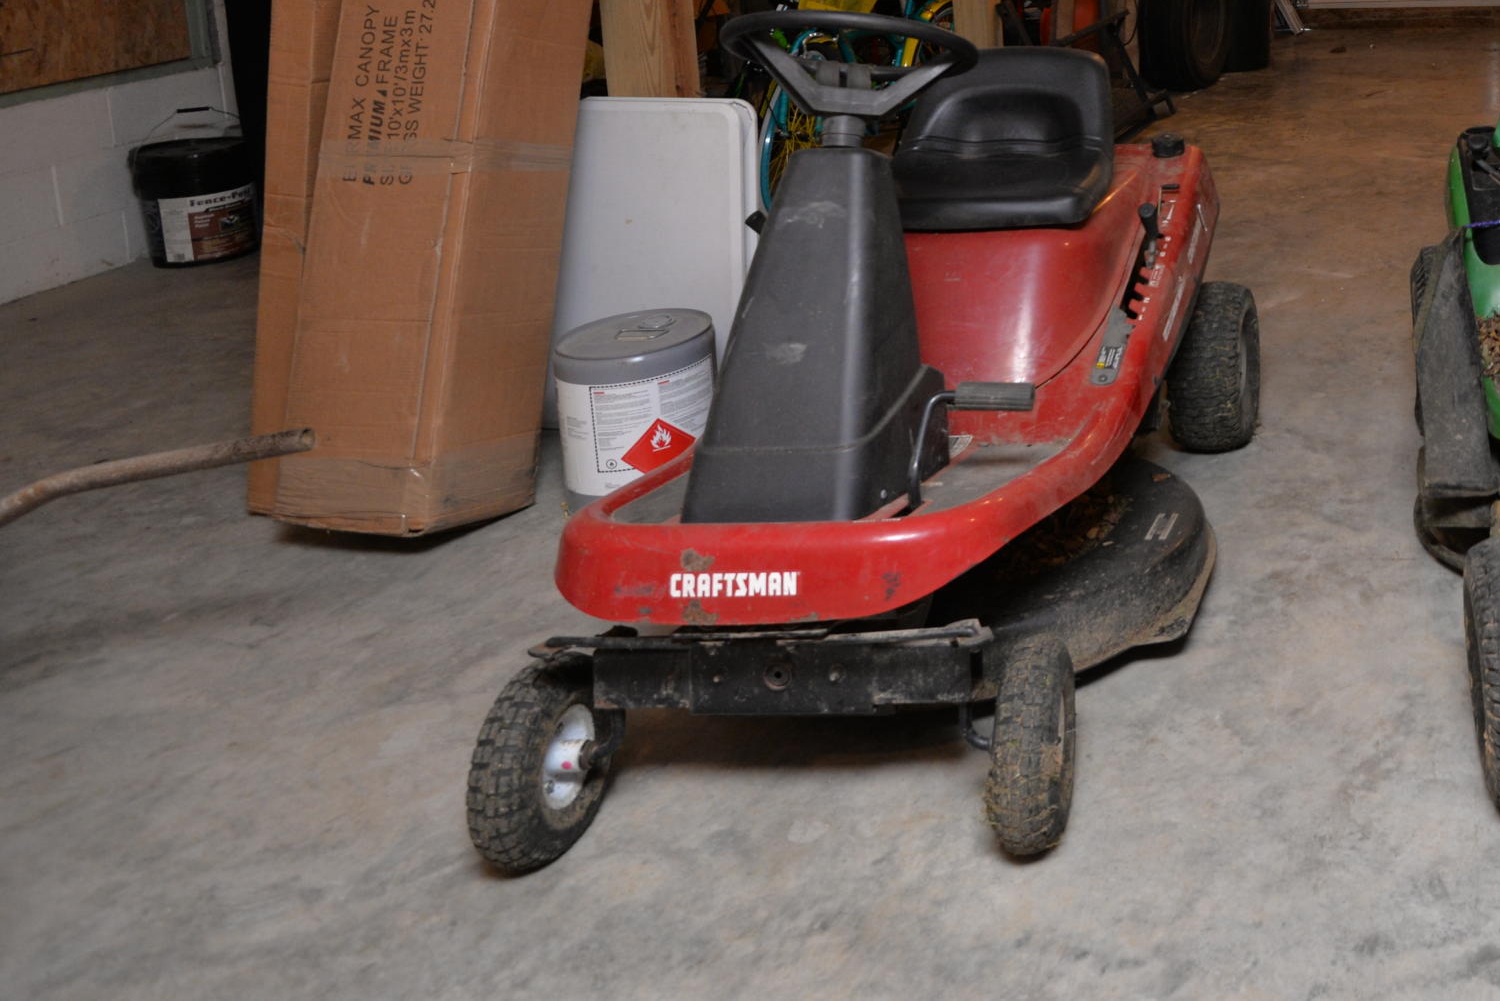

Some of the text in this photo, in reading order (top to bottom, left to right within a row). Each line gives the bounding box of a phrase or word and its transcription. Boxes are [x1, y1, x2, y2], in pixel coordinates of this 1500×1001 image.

[355, 5, 380, 87] CANOPY
[362, 15, 398, 186] PRMIUM FRAME
[398, 119, 420, 185] GSS
[669, 571, 798, 598] CRAFTSMAN
